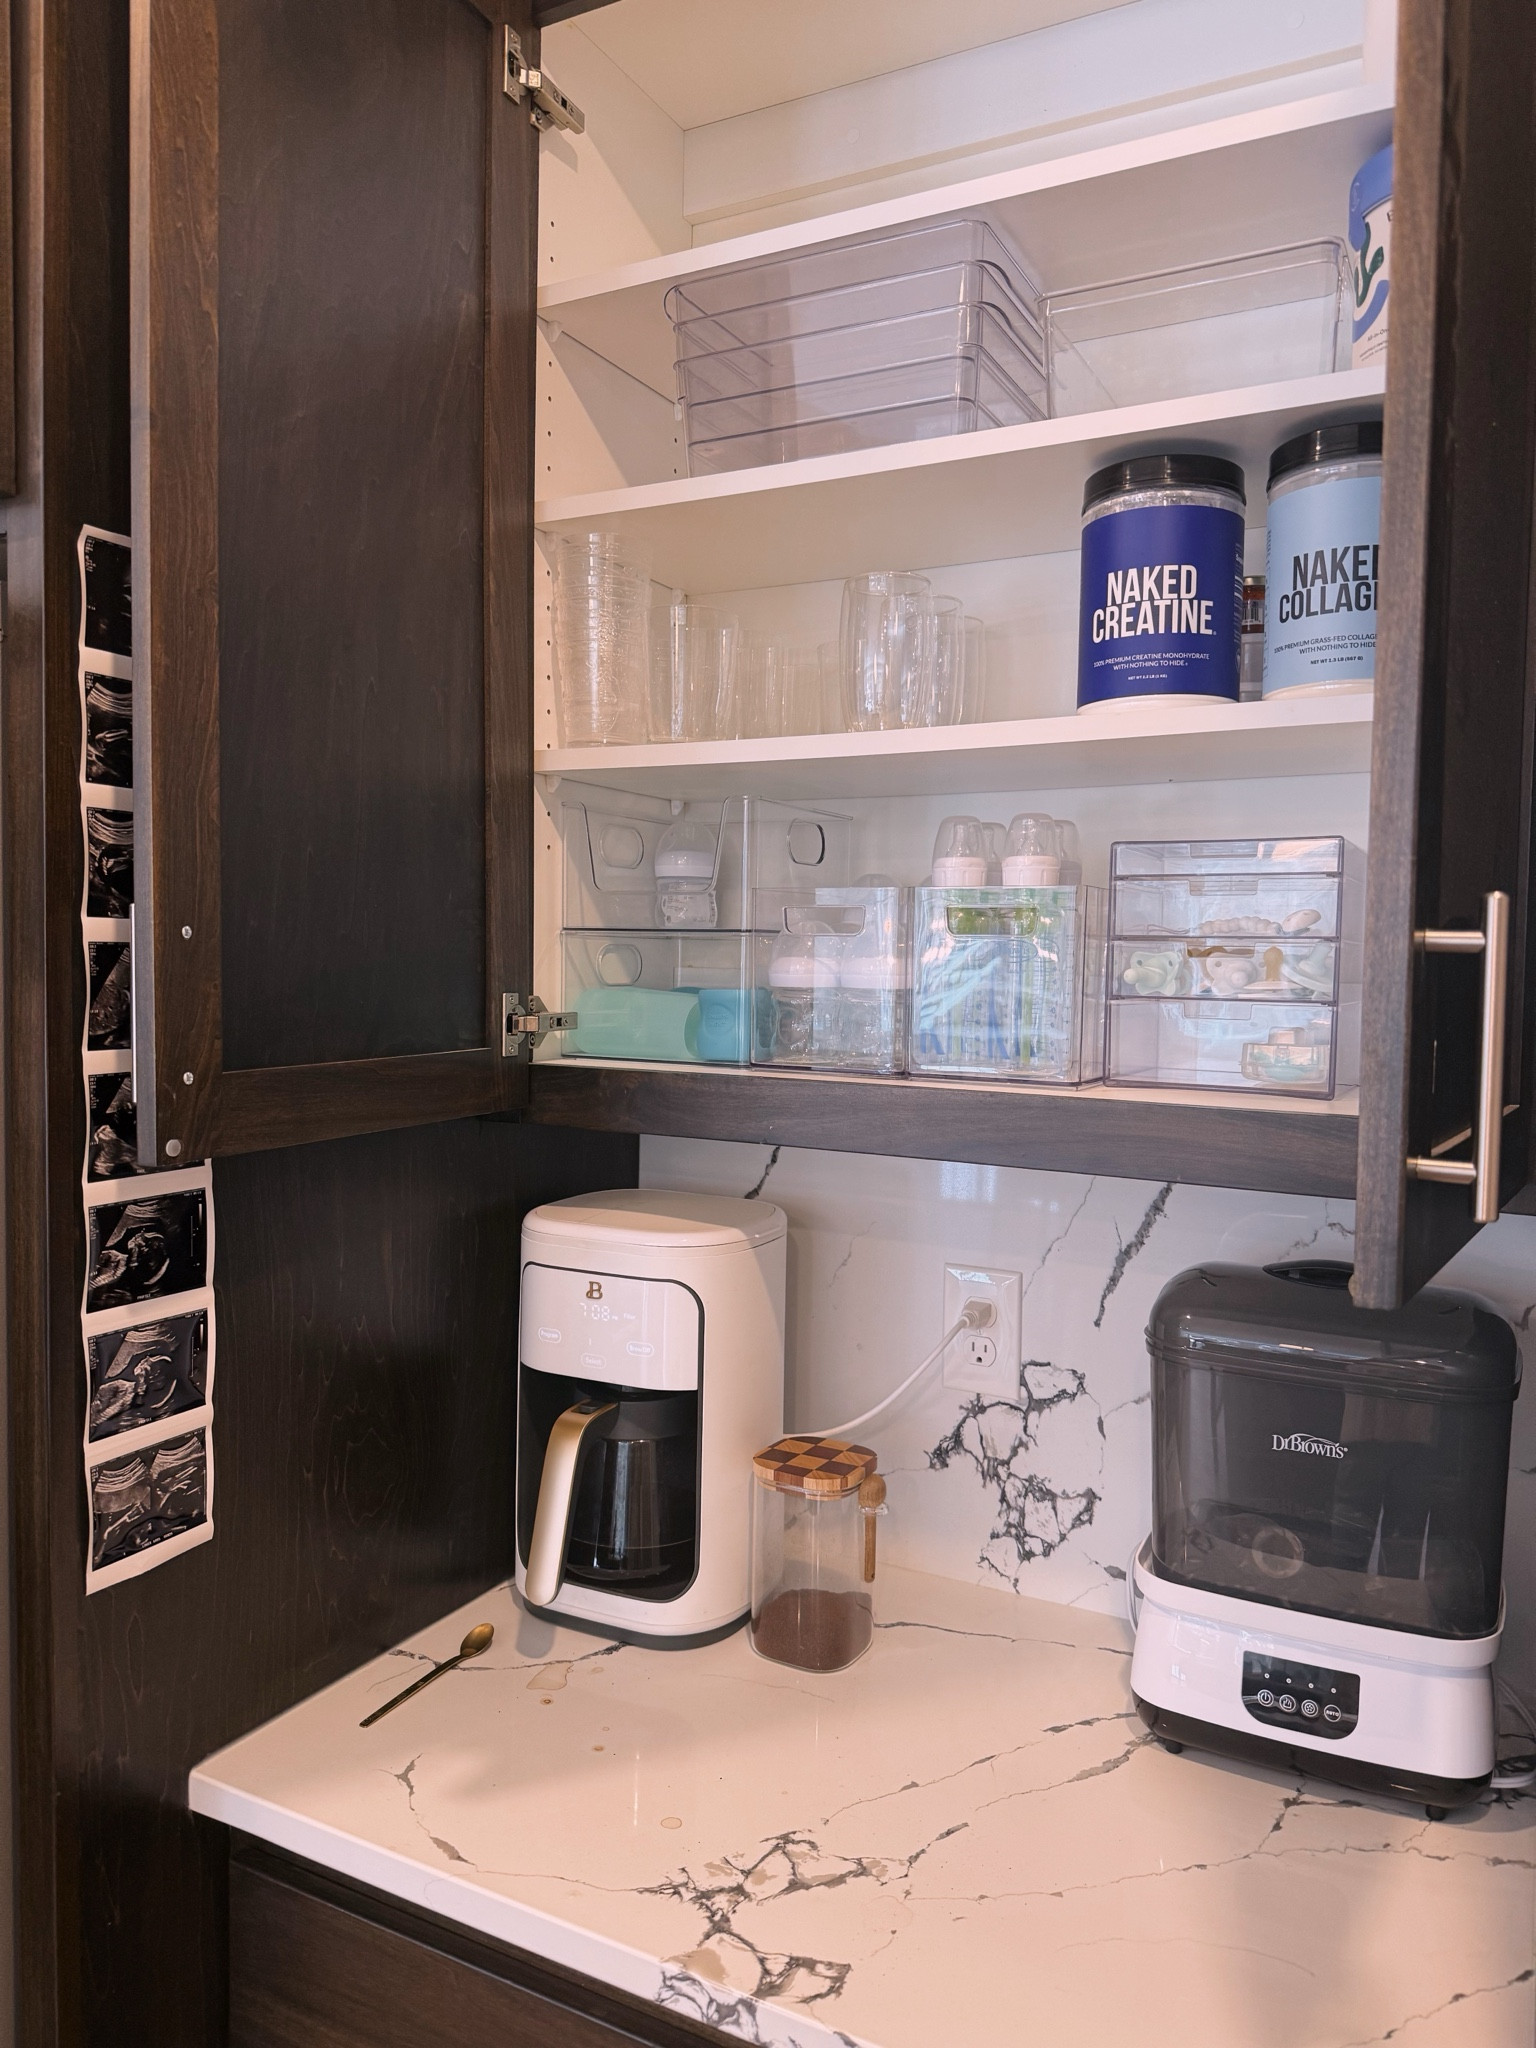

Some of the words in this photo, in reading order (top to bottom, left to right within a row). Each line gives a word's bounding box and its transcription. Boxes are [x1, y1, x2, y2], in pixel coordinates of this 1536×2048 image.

[1107, 564, 1197, 606] NAKED
[1279, 581, 1378, 623] COLLAG
[1092, 599, 1214, 643] CREATINE
[1284, 640, 1310, 650] PREMIUM
[1310, 635, 1346, 645] GRASS-FED
[1299, 646, 1316, 654] WITH
[1316, 643, 1348, 652] NOTHING
[1105, 656, 1131, 665] PREMIUM
[1132, 653, 1161, 661] CREATINE
[1162, 652, 1210, 660] MONOHYDRATE
[1113, 663, 1129, 671] WITH
[1129, 660, 1159, 669] NOTHING
[586, 1281, 603, 1300] B
[1325, 1709, 1340, 1717] AUTO
